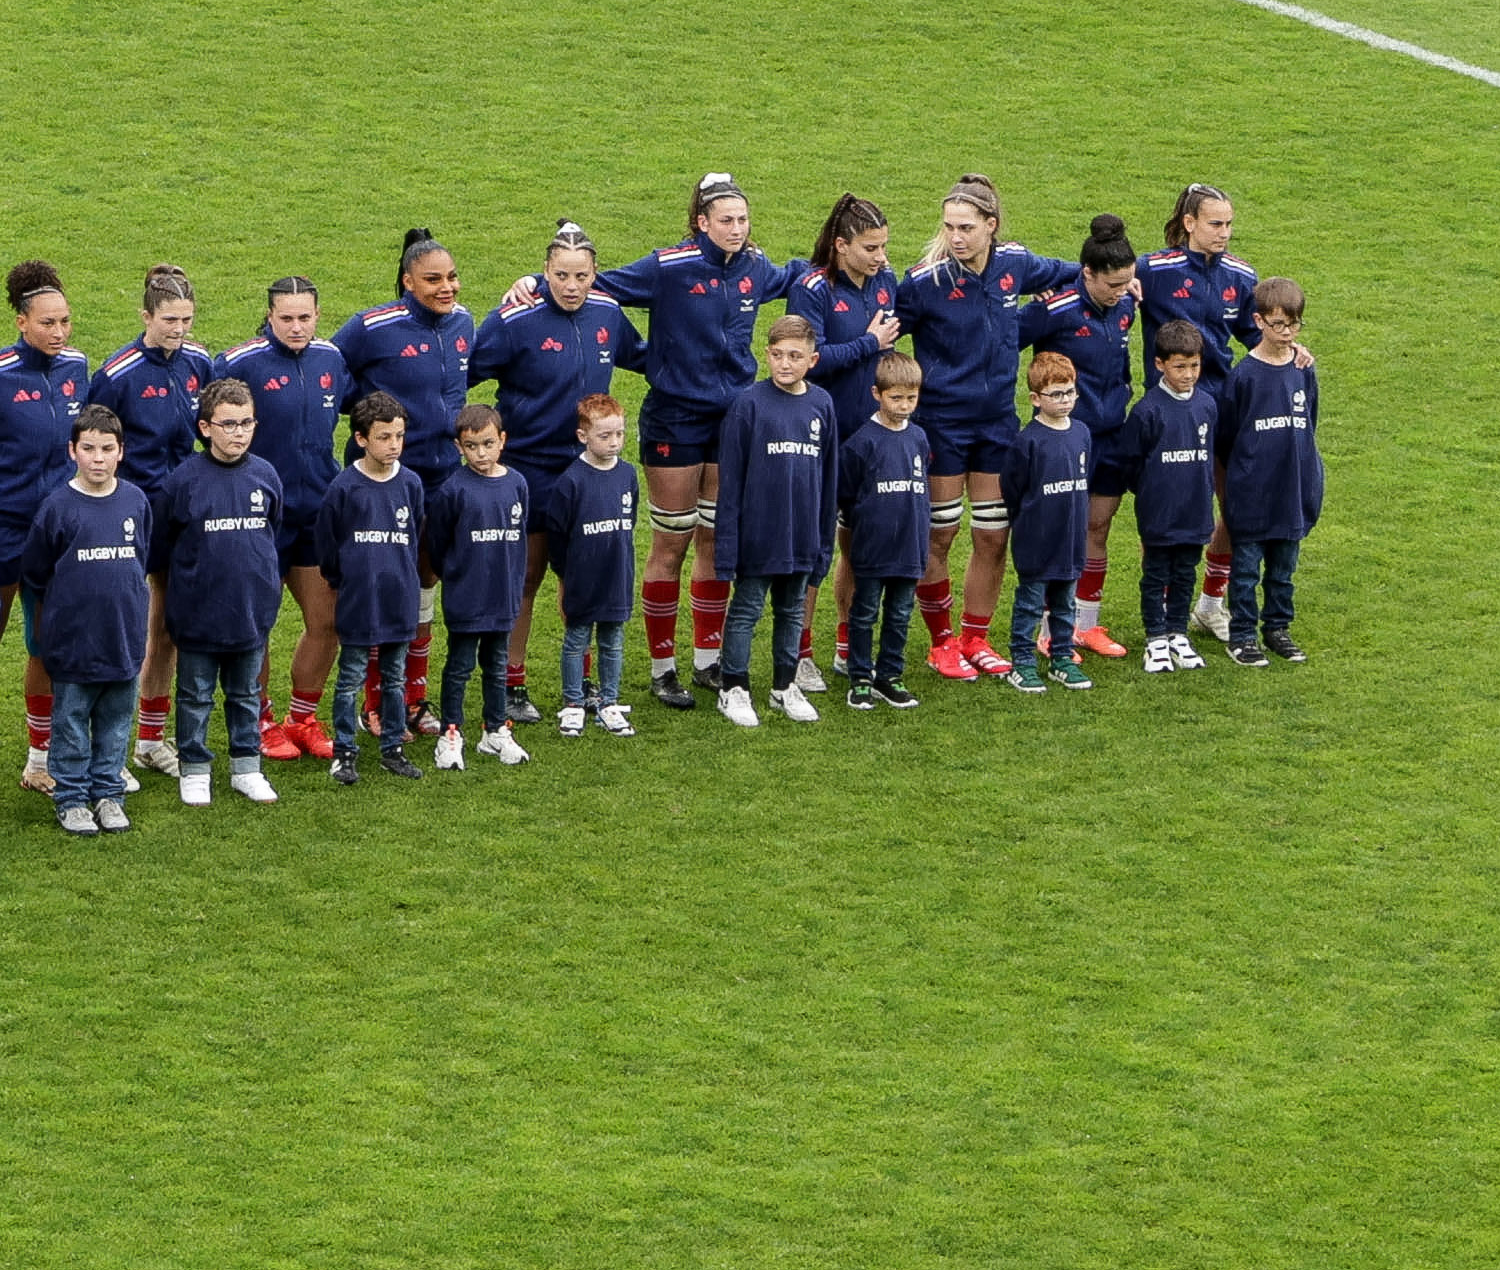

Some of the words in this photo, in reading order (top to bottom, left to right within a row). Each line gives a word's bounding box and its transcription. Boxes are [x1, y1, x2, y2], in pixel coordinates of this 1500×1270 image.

[1256, 416, 1291, 431] RUGBY
[768, 441, 802, 455] RUGBY
[1162, 450, 1196, 463] RUGBY
[878, 480, 912, 494] RUGBY
[205, 518, 241, 532] RUGBY
[243, 517, 267, 529] KIDS
[583, 519, 620, 535] RUGBY
[355, 531, 390, 543] RUGBY
[471, 529, 504, 542] RUGBY
[78, 547, 118, 561] RUGBY
